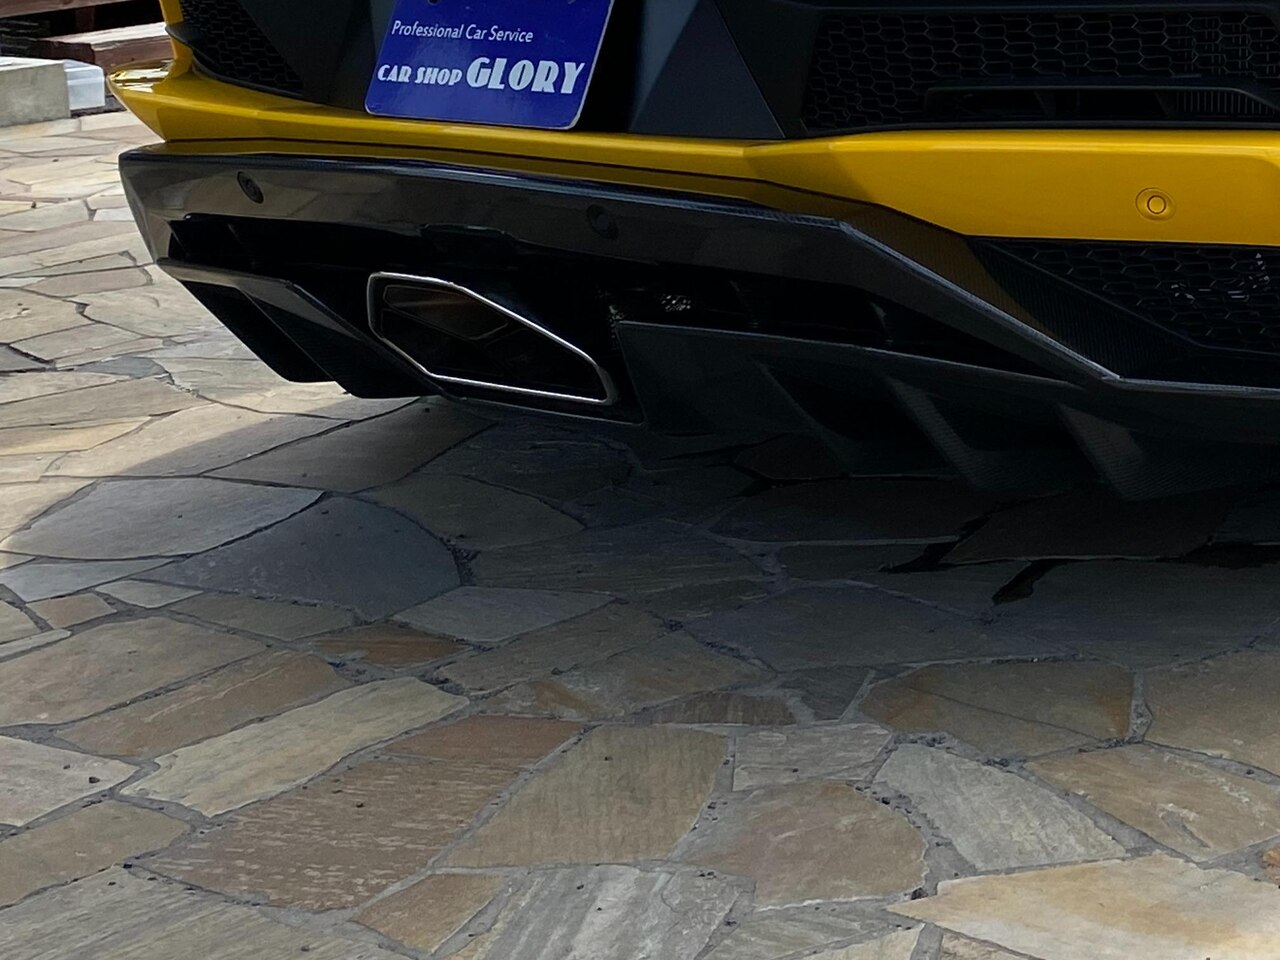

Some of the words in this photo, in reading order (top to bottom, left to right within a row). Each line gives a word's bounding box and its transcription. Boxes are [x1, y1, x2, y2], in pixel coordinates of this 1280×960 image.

[391, 20, 464, 39] Professional
[465, 24, 488, 40] Car
[488, 25, 534, 43] Service
[377, 64, 412, 83] CAR
[414, 66, 463, 86] SHOP
[466, 56, 586, 94] GLORY
